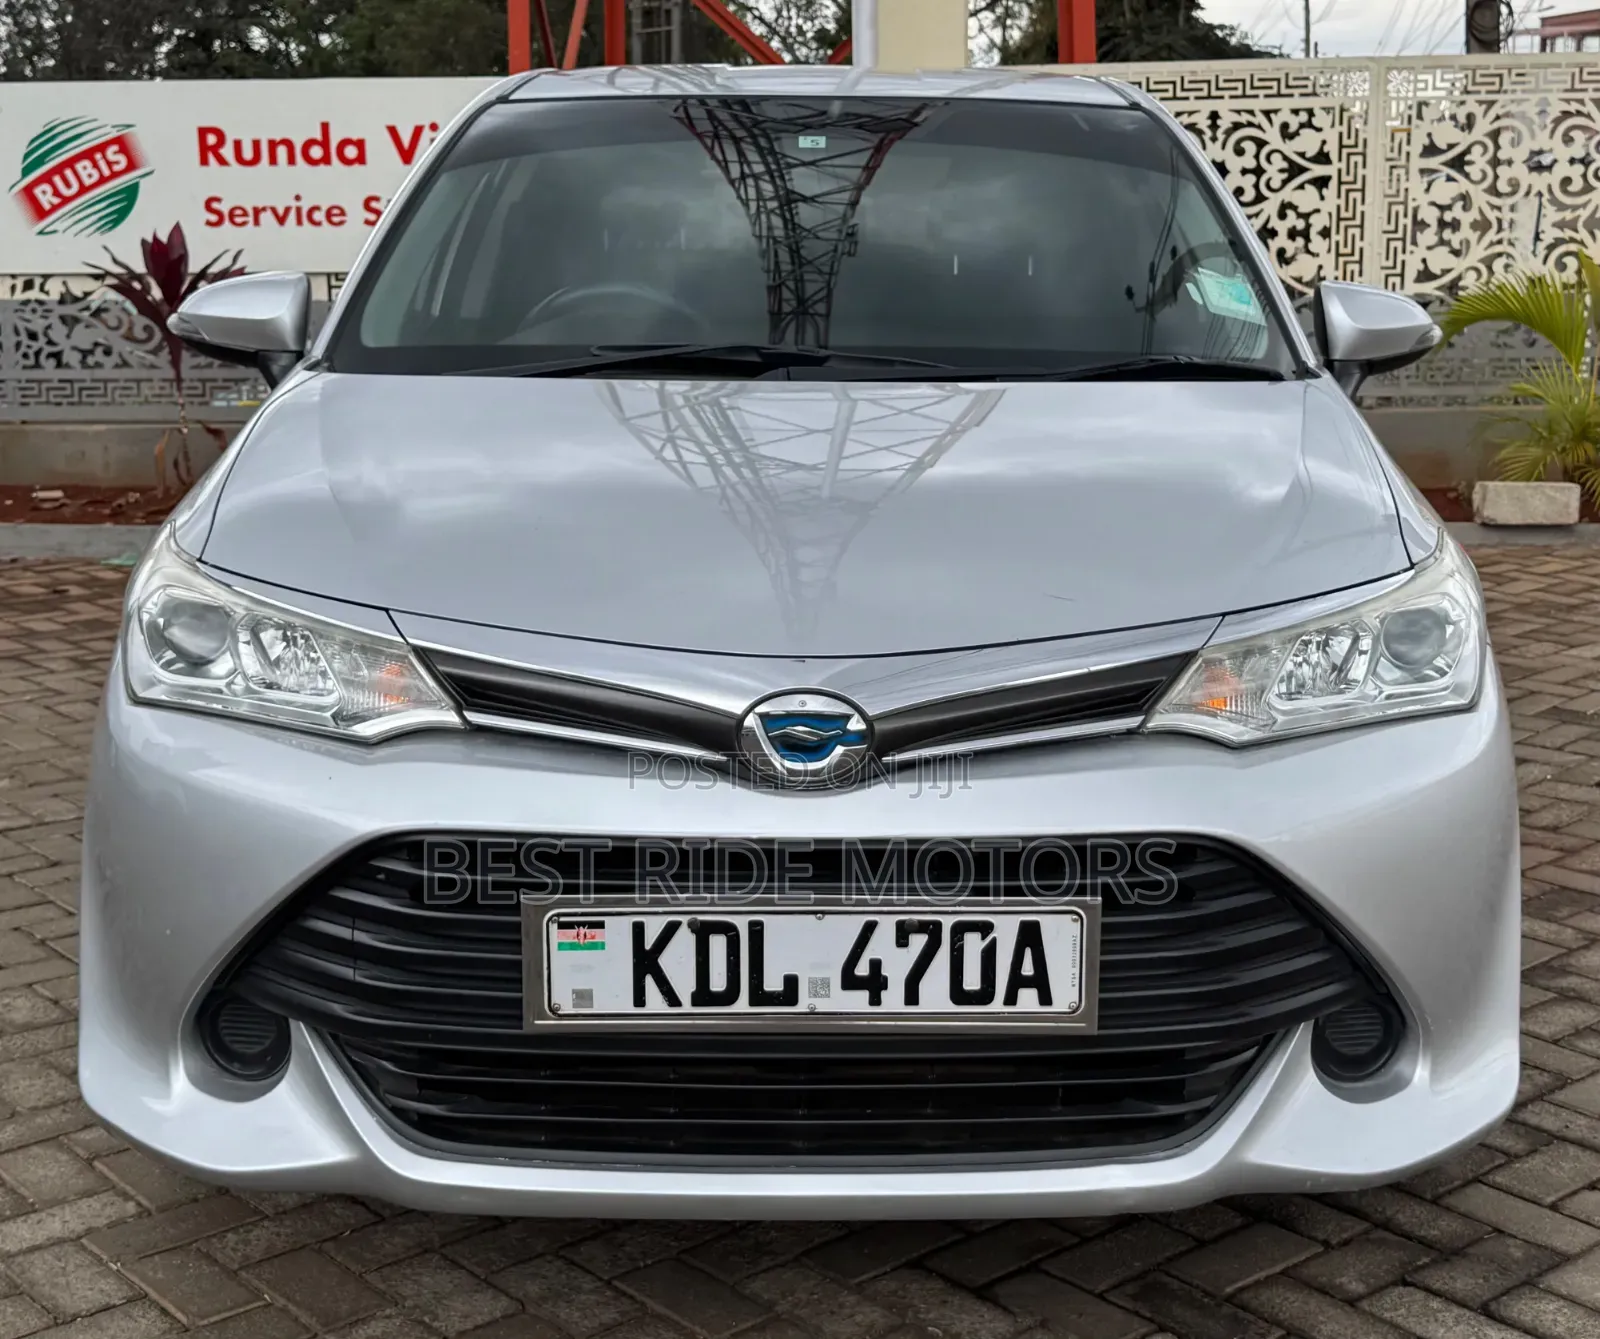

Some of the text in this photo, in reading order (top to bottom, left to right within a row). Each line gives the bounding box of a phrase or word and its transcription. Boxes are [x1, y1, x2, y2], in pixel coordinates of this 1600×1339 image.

[197, 121, 367, 167] Runda
[204, 195, 347, 228] Service
[631, 919, 799, 1008] KDL
[840, 919, 1054, 1008] 470A
